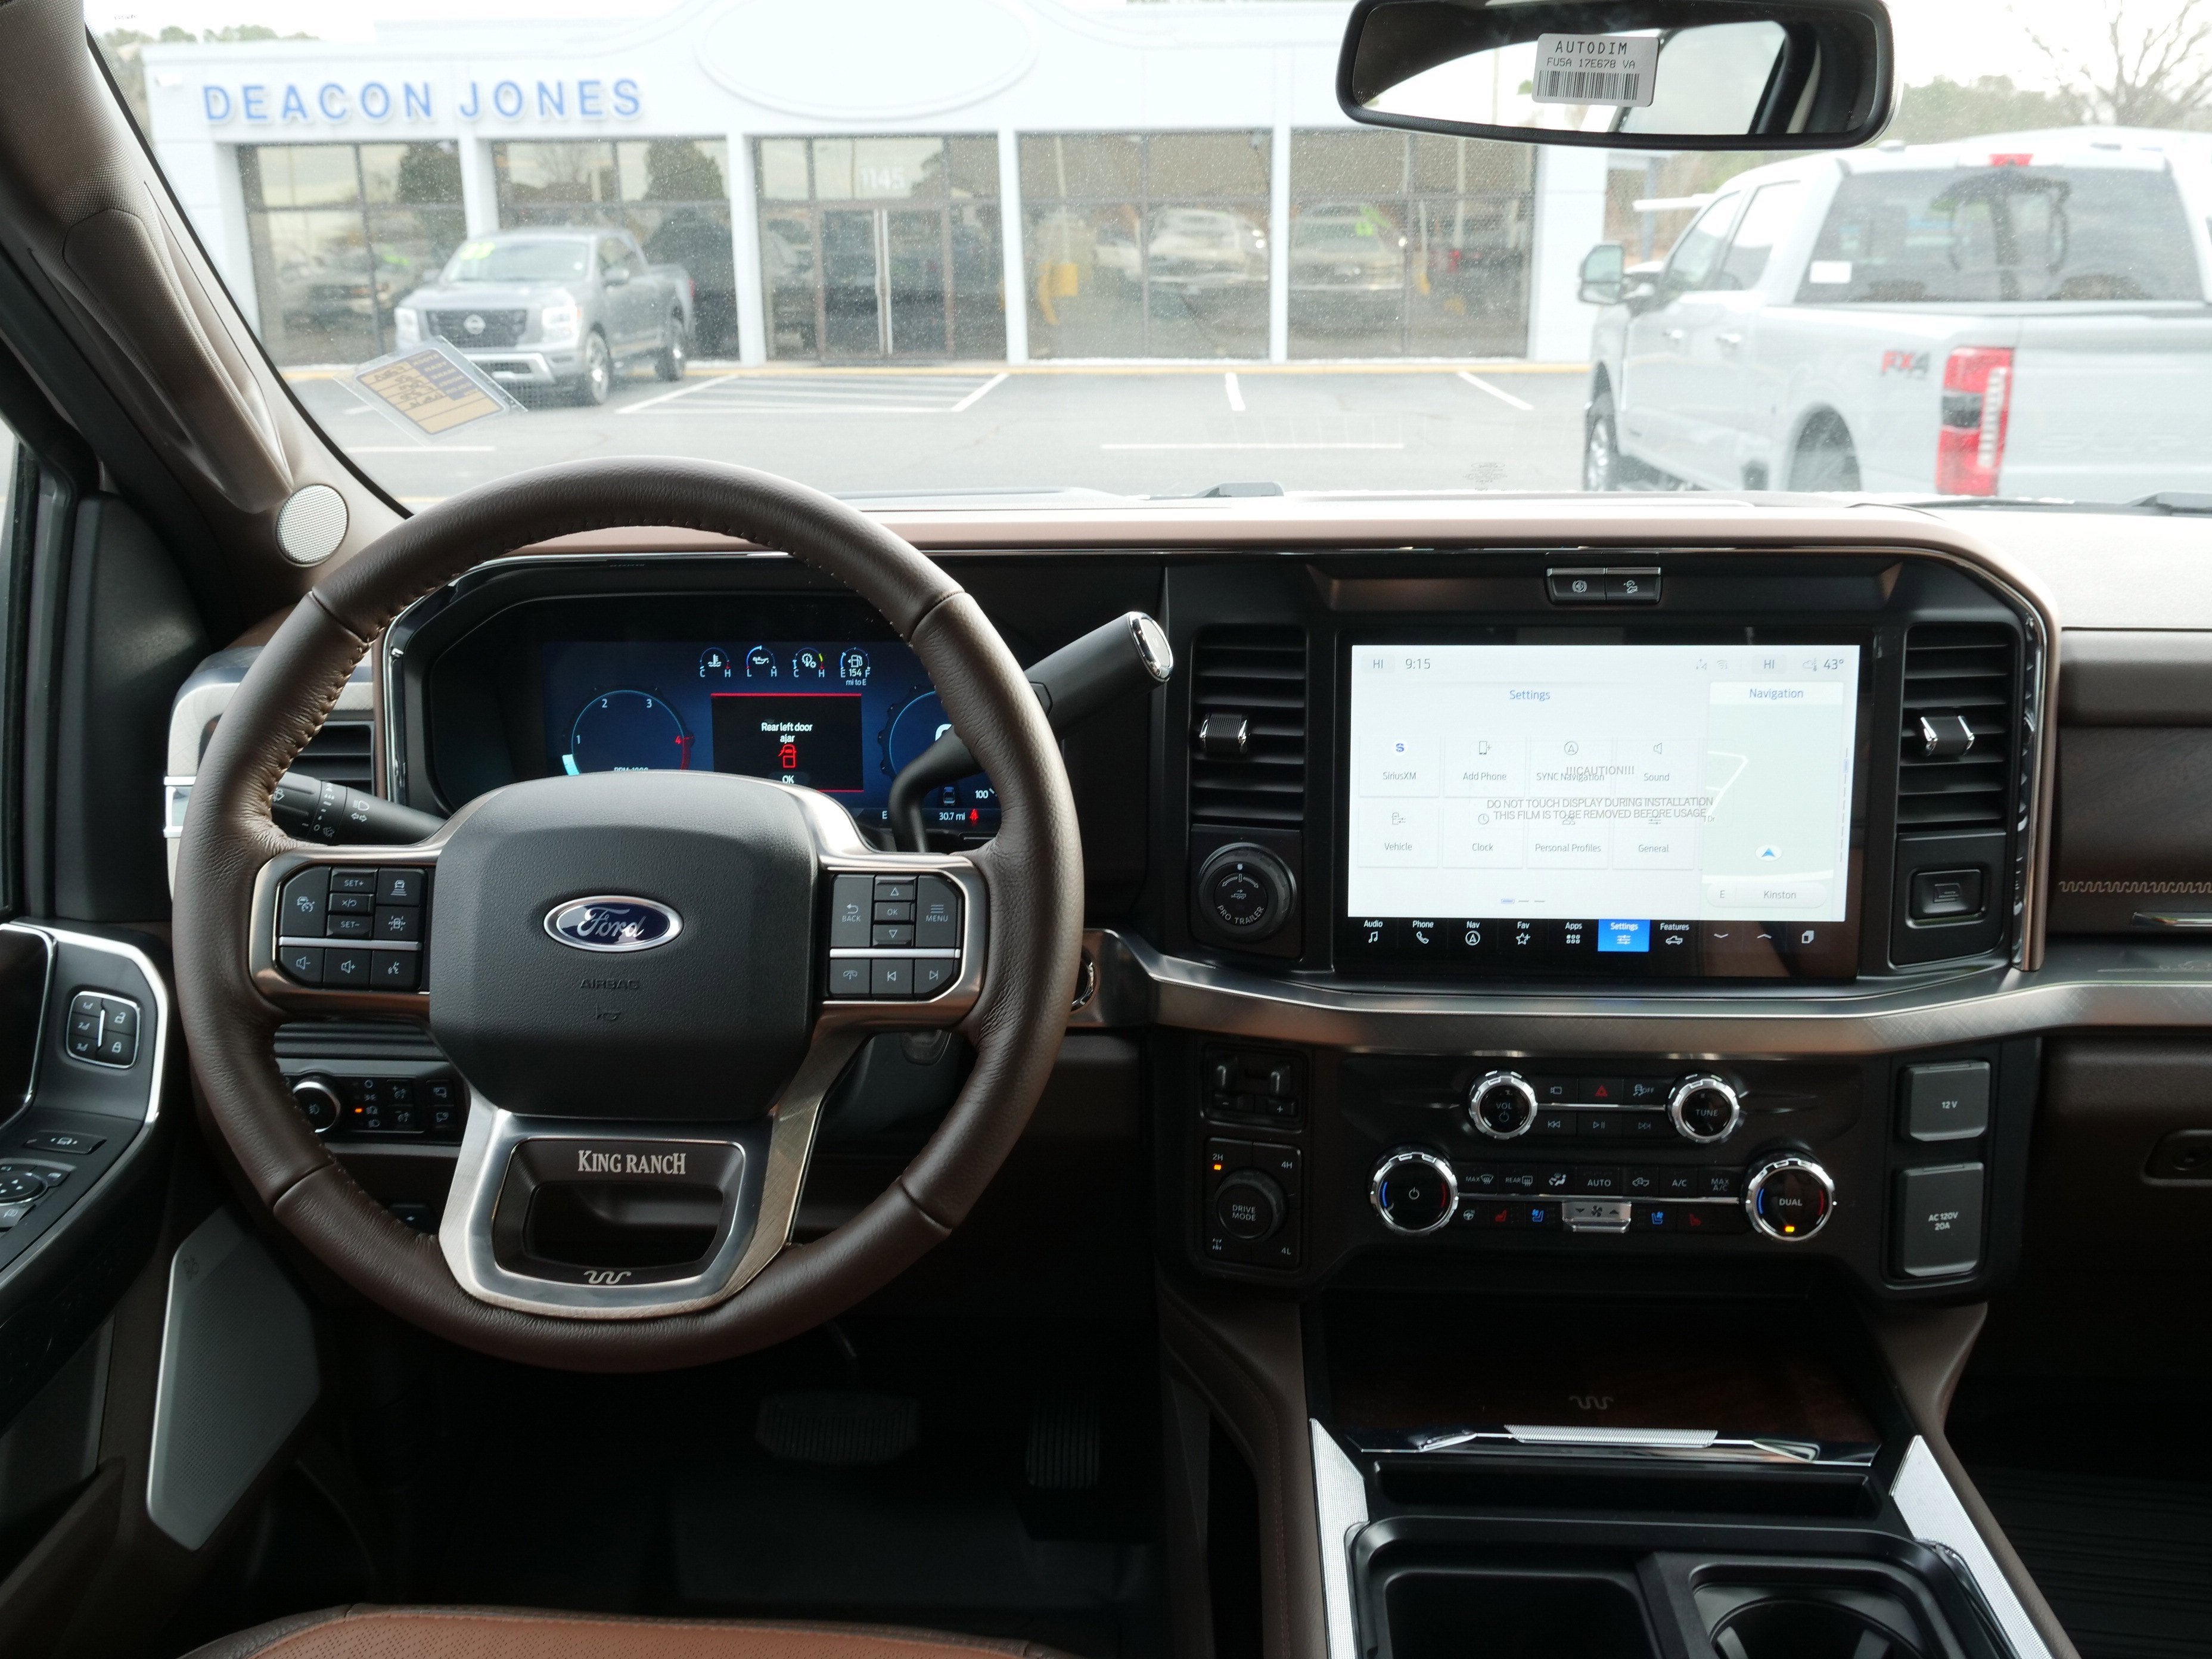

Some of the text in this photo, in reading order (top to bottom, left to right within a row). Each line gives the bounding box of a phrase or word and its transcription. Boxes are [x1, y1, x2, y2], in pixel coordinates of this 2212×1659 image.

[1555, 40, 1628, 55] AUTODIM
[1546, 57, 1572, 67] FU5A
[1623, 60, 1636, 69] VA
[204, 78, 642, 120] DEACON JONES
[1880, 350, 1931, 376] FX4
[1373, 660, 1383, 669] HI
[1405, 658, 1431, 670] 9:15
[1763, 660, 1775, 670] HI
[700, 669, 706, 678] C
[725, 669, 731, 678] H
[747, 669, 752, 677] L
[771, 669, 778, 677] H
[793, 669, 799, 678] C
[819, 669, 825, 678] H
[840, 669, 846, 678] E
[849, 668, 862, 677] 154
[865, 669, 871, 678] F
[1509, 690, 1551, 701] Settings
[1750, 688, 1803, 700] Navigation
[602, 698, 608, 708] 2
[647, 698, 653, 708] 3
[761, 722, 813, 731] Rear left door
[576, 735, 580, 744] 1
[675, 735, 682, 744] 4
[780, 734, 795, 744] ajar
[782, 775, 794, 784] OK
[1382, 771, 1416, 781] SiriusXM
[1462, 772, 1506, 781] Add Phone
[1536, 772, 1604, 782] SYNC Navigation
[1644, 773, 1670, 782] Sound
[975, 790, 988, 799] 100
[1487, 797, 1713, 809] DO NOT TOUCH DISPLAY DURING INSTALLATION
[939, 812, 965, 821] 30.7 mi
[1493, 808, 1706, 820] THIS FILM IS TO BE REMOVED BEFORE USAGE
[1385, 843, 1412, 851] Vehicle
[1472, 843, 1493, 852] Clock
[1535, 844, 1601, 852] Personal Profiles
[1638, 844, 1669, 853] General
[1720, 890, 1725, 899] E
[1763, 890, 1797, 899] Kinston
[1217, 905, 1265, 925] PRO TRAILER
[577, 906, 647, 938] Ford
[1517, 921, 1530, 930] Fav
[1565, 922, 1582, 931] Apps
[1610, 922, 1638, 931] Settings
[1660, 922, 1689, 931] Features
[580, 978, 640, 990] AIRBAG
[1695, 1109, 1719, 1117] TUNE
[577, 1150, 686, 1175] KING RANCH
[1672, 1179, 1687, 1187] A/C
[1779, 1198, 1803, 1207] DUAL
[1232, 1204, 1256, 1214] DRIVE
[1232, 1212, 1256, 1222] MODE
[1940, 1211, 1959, 1221] 120V
[1934, 1222, 1950, 1231] 20A
